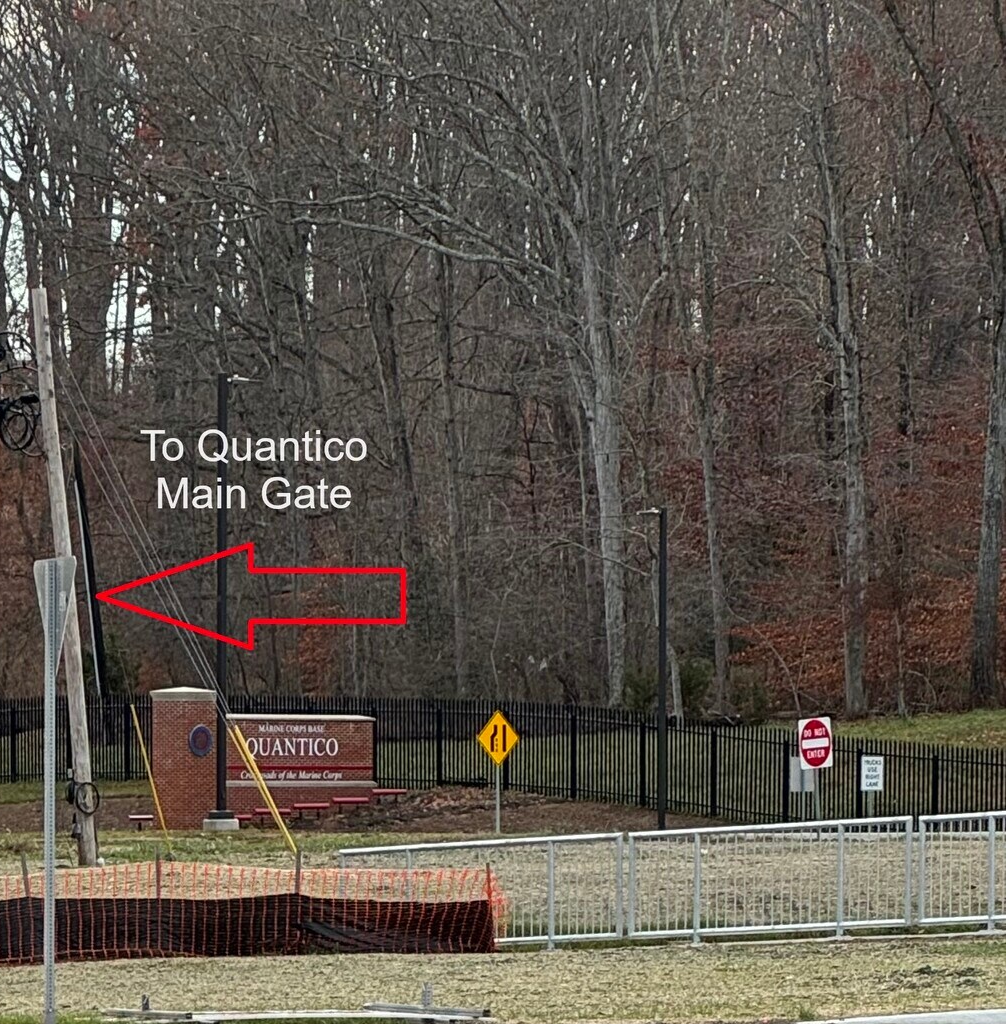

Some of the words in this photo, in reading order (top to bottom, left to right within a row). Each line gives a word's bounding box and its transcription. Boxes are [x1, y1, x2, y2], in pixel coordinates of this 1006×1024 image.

[258, 724, 285, 733] MARINE
[285, 724, 307, 733] CORPS
[307, 724, 325, 733] BASE
[803, 729, 812, 738] DO
[814, 727, 826, 737] NOT
[245, 737, 339, 760] QUANTICO
[806, 749, 825, 759] ENTER
[298, 771, 322, 780] Marine
[322, 770, 343, 781] Corps
